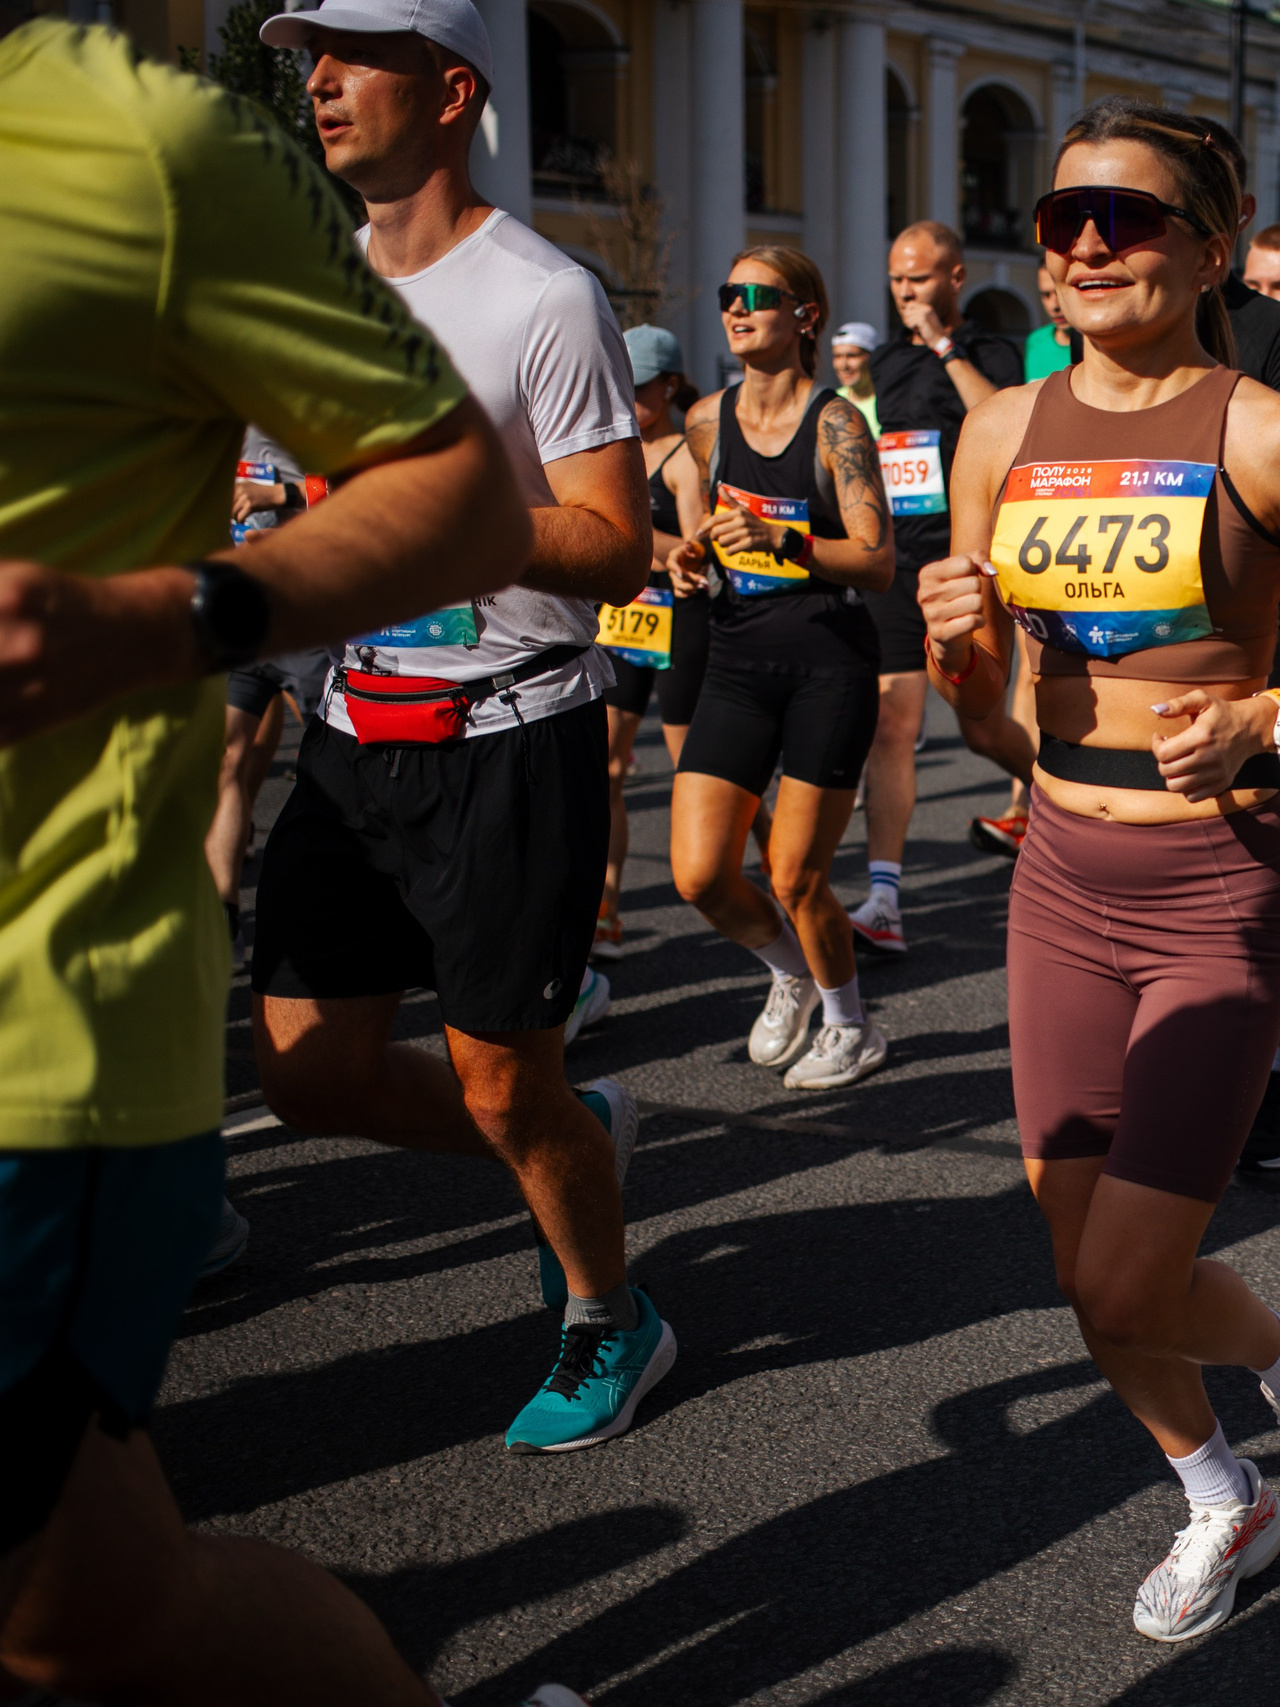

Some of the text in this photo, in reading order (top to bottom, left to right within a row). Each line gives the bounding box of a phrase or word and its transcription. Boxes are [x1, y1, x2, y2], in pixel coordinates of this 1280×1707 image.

[1032, 466, 1066, 478] ПОЛУ
[1119, 471, 1184, 487] 21,1 КМ
[1030, 475, 1092, 488] МАРАФОН
[1018, 513, 1171, 575] 6473
[738, 556, 771, 569] ДАРЬЯ
[1064, 582, 1126, 599] ОЛЬГА
[606, 608, 660, 636] 5179
